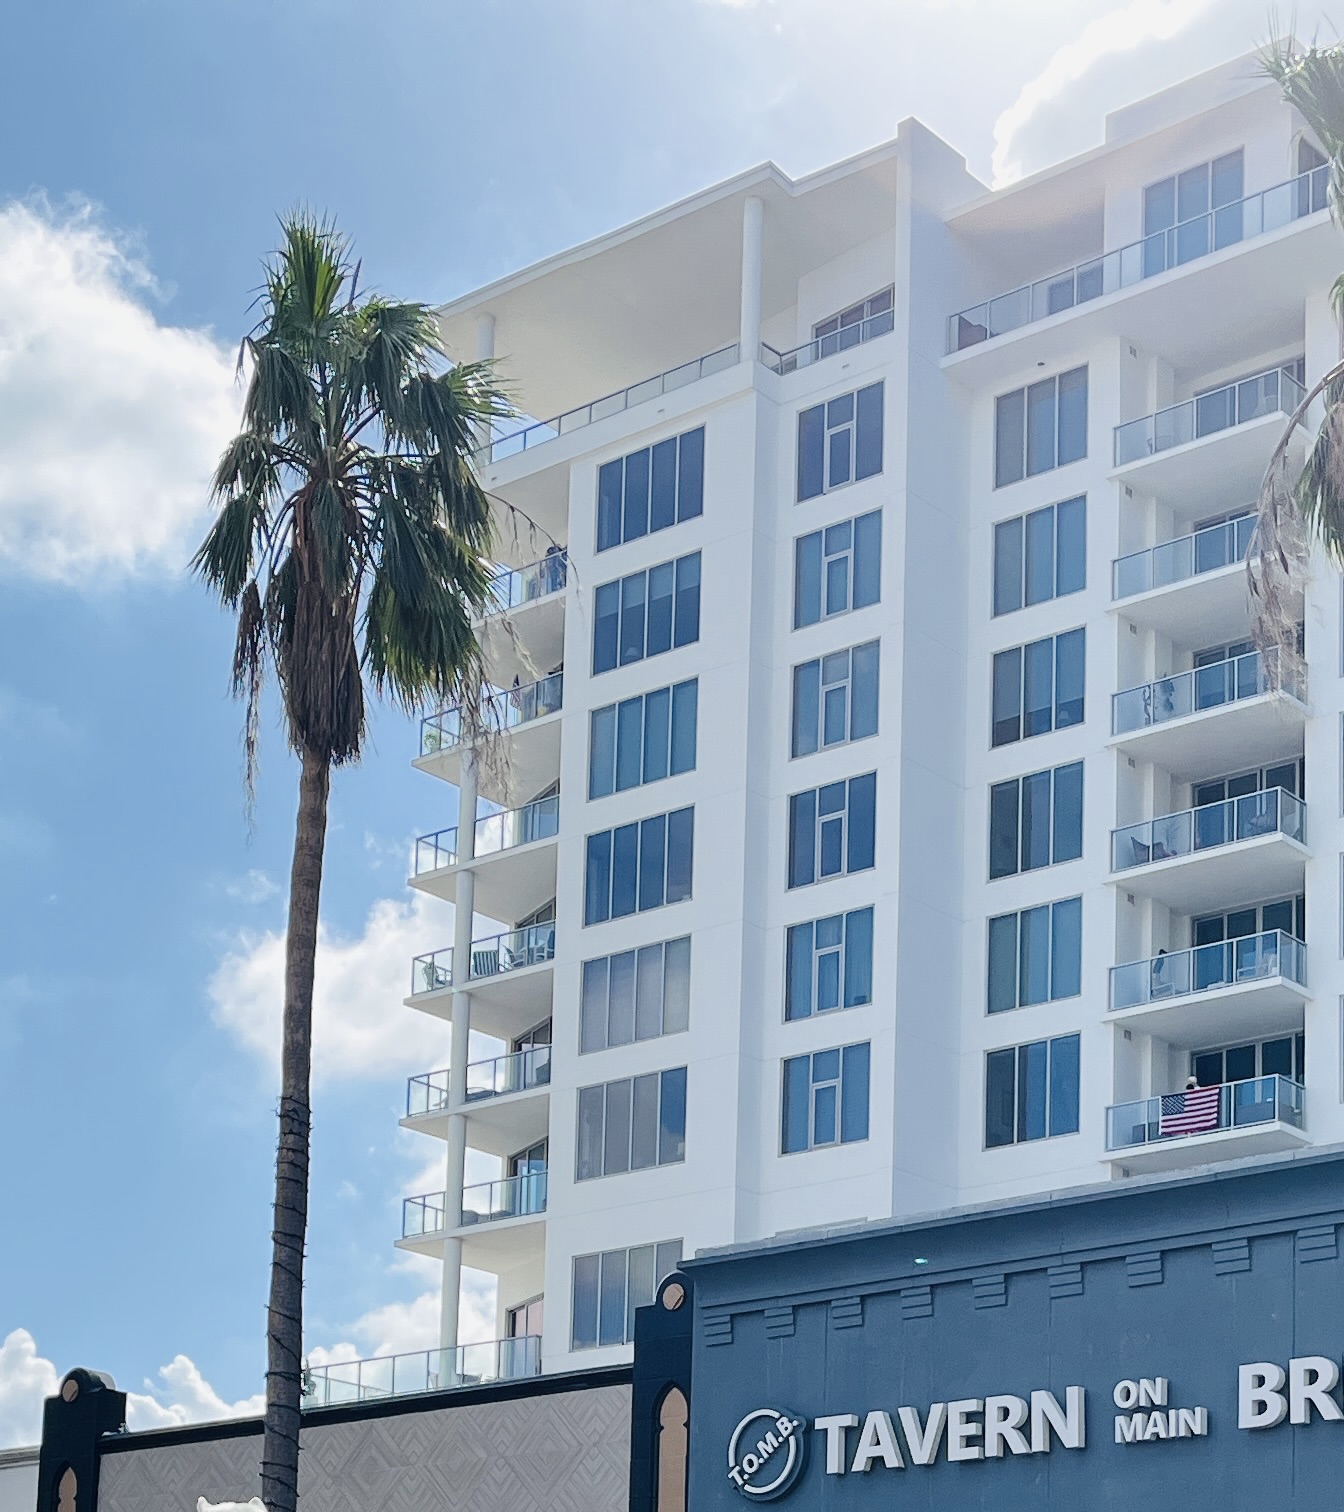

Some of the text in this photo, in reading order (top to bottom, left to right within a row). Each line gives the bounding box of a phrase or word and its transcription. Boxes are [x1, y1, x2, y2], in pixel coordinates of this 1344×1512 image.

[1113, 1376, 1169, 1410] ON
[814, 1385, 1086, 1475] TAVERN
[1113, 1405, 1208, 1444] MAIN
